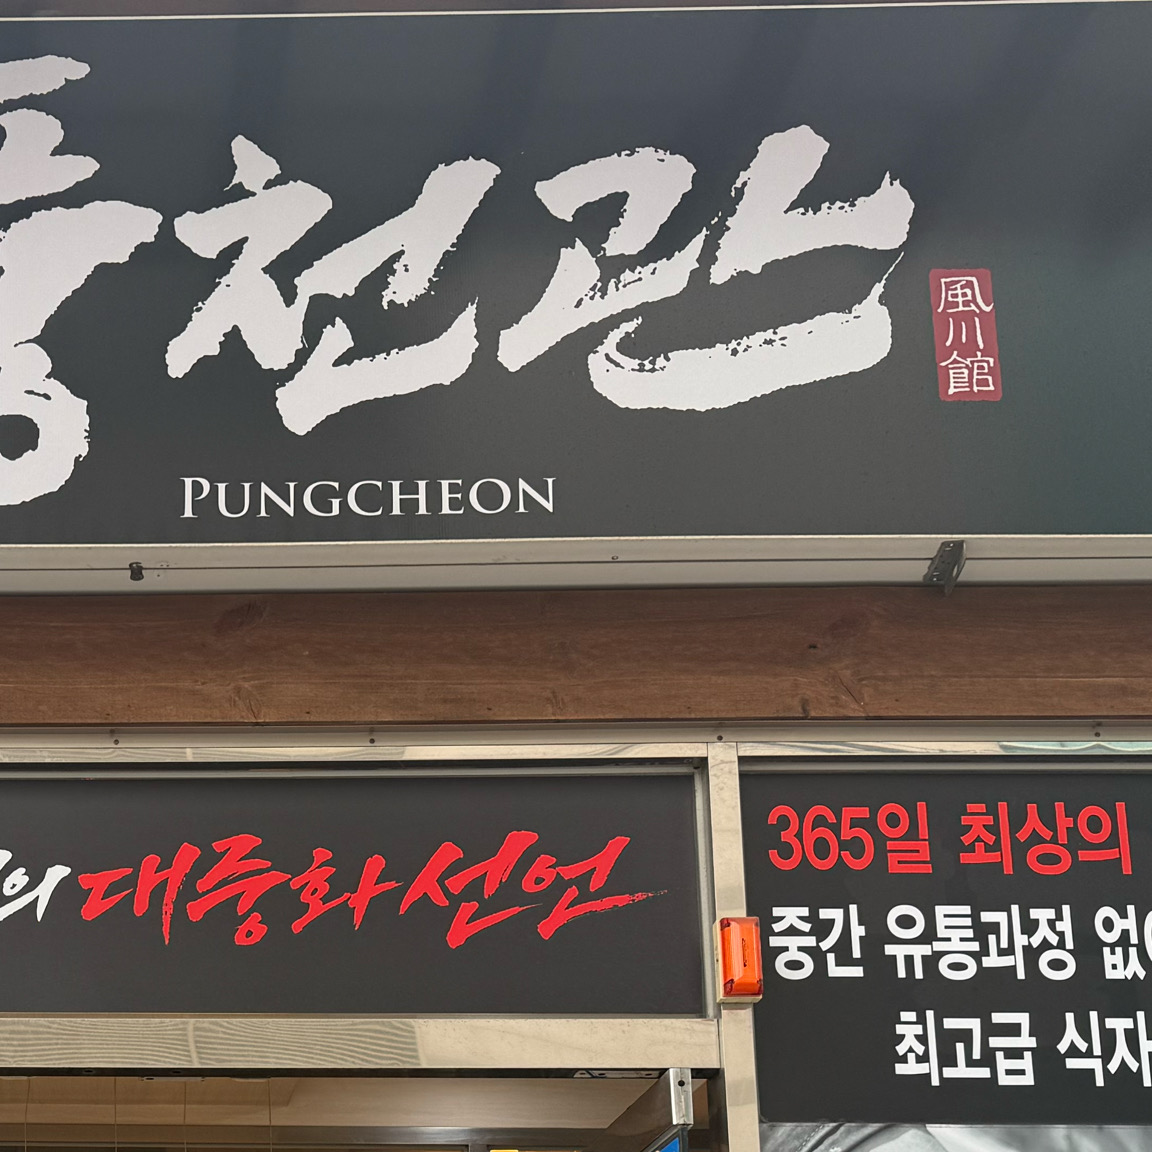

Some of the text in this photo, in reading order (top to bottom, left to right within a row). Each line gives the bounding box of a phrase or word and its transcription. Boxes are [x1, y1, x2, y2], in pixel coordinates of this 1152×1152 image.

[937, 274, 997, 397] 風川館
[768, 802, 1132, 875] 365일 최상의
[78, 833, 400, 946] 대중화
[398, 830, 668, 949] 선언
[769, 905, 865, 980] 중간
[885, 905, 1076, 980] 유통과정
[895, 1010, 1036, 1086] 최고급
